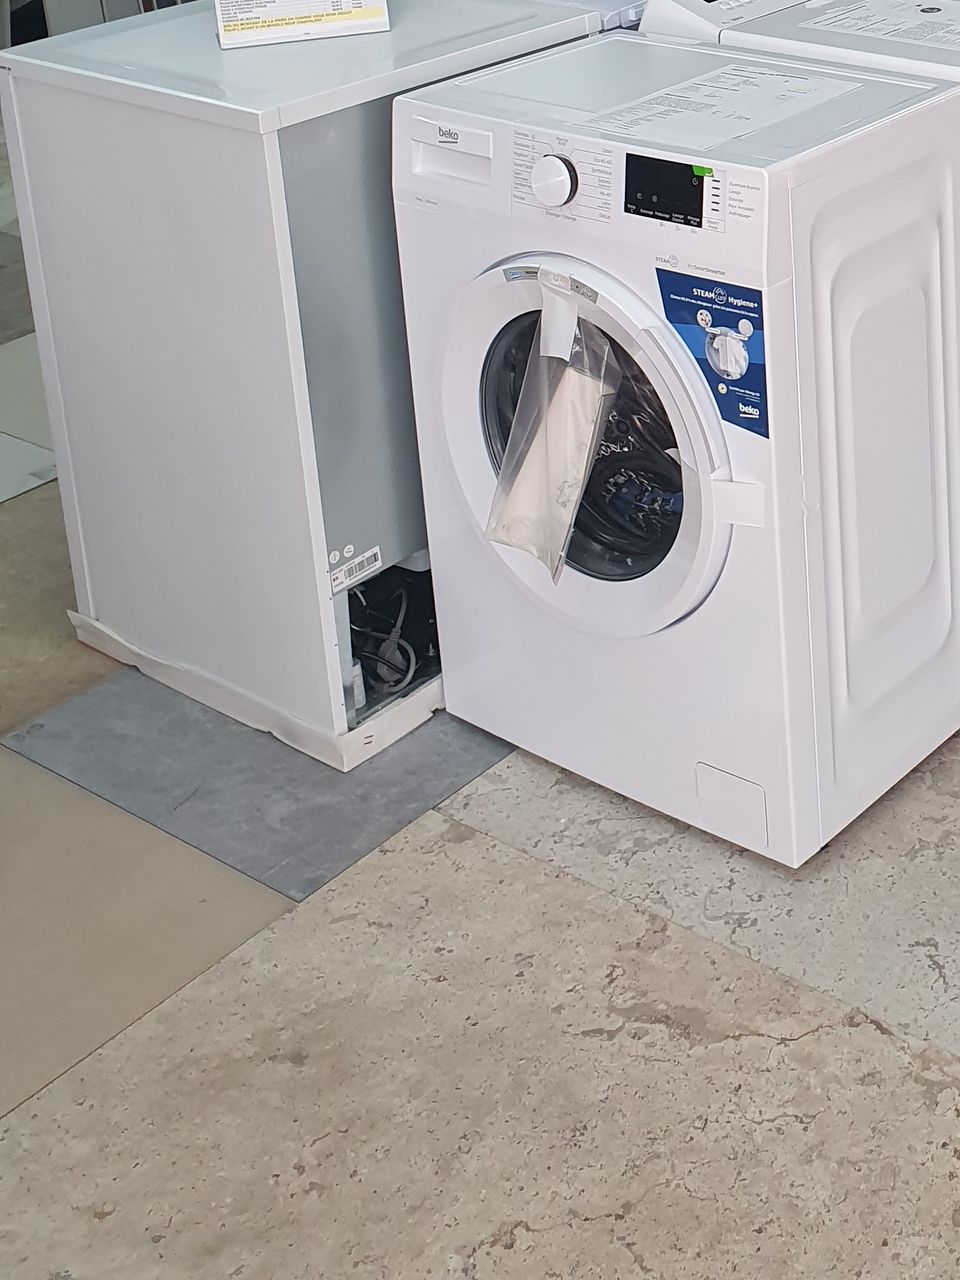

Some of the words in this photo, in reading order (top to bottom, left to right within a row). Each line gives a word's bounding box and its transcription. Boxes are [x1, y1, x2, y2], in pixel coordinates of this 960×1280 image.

[438, 125, 459, 140] beko
[693, 288, 715, 299] STEAM
[728, 295, 759, 308] Hygiene+
[738, 402, 760, 415] beko
